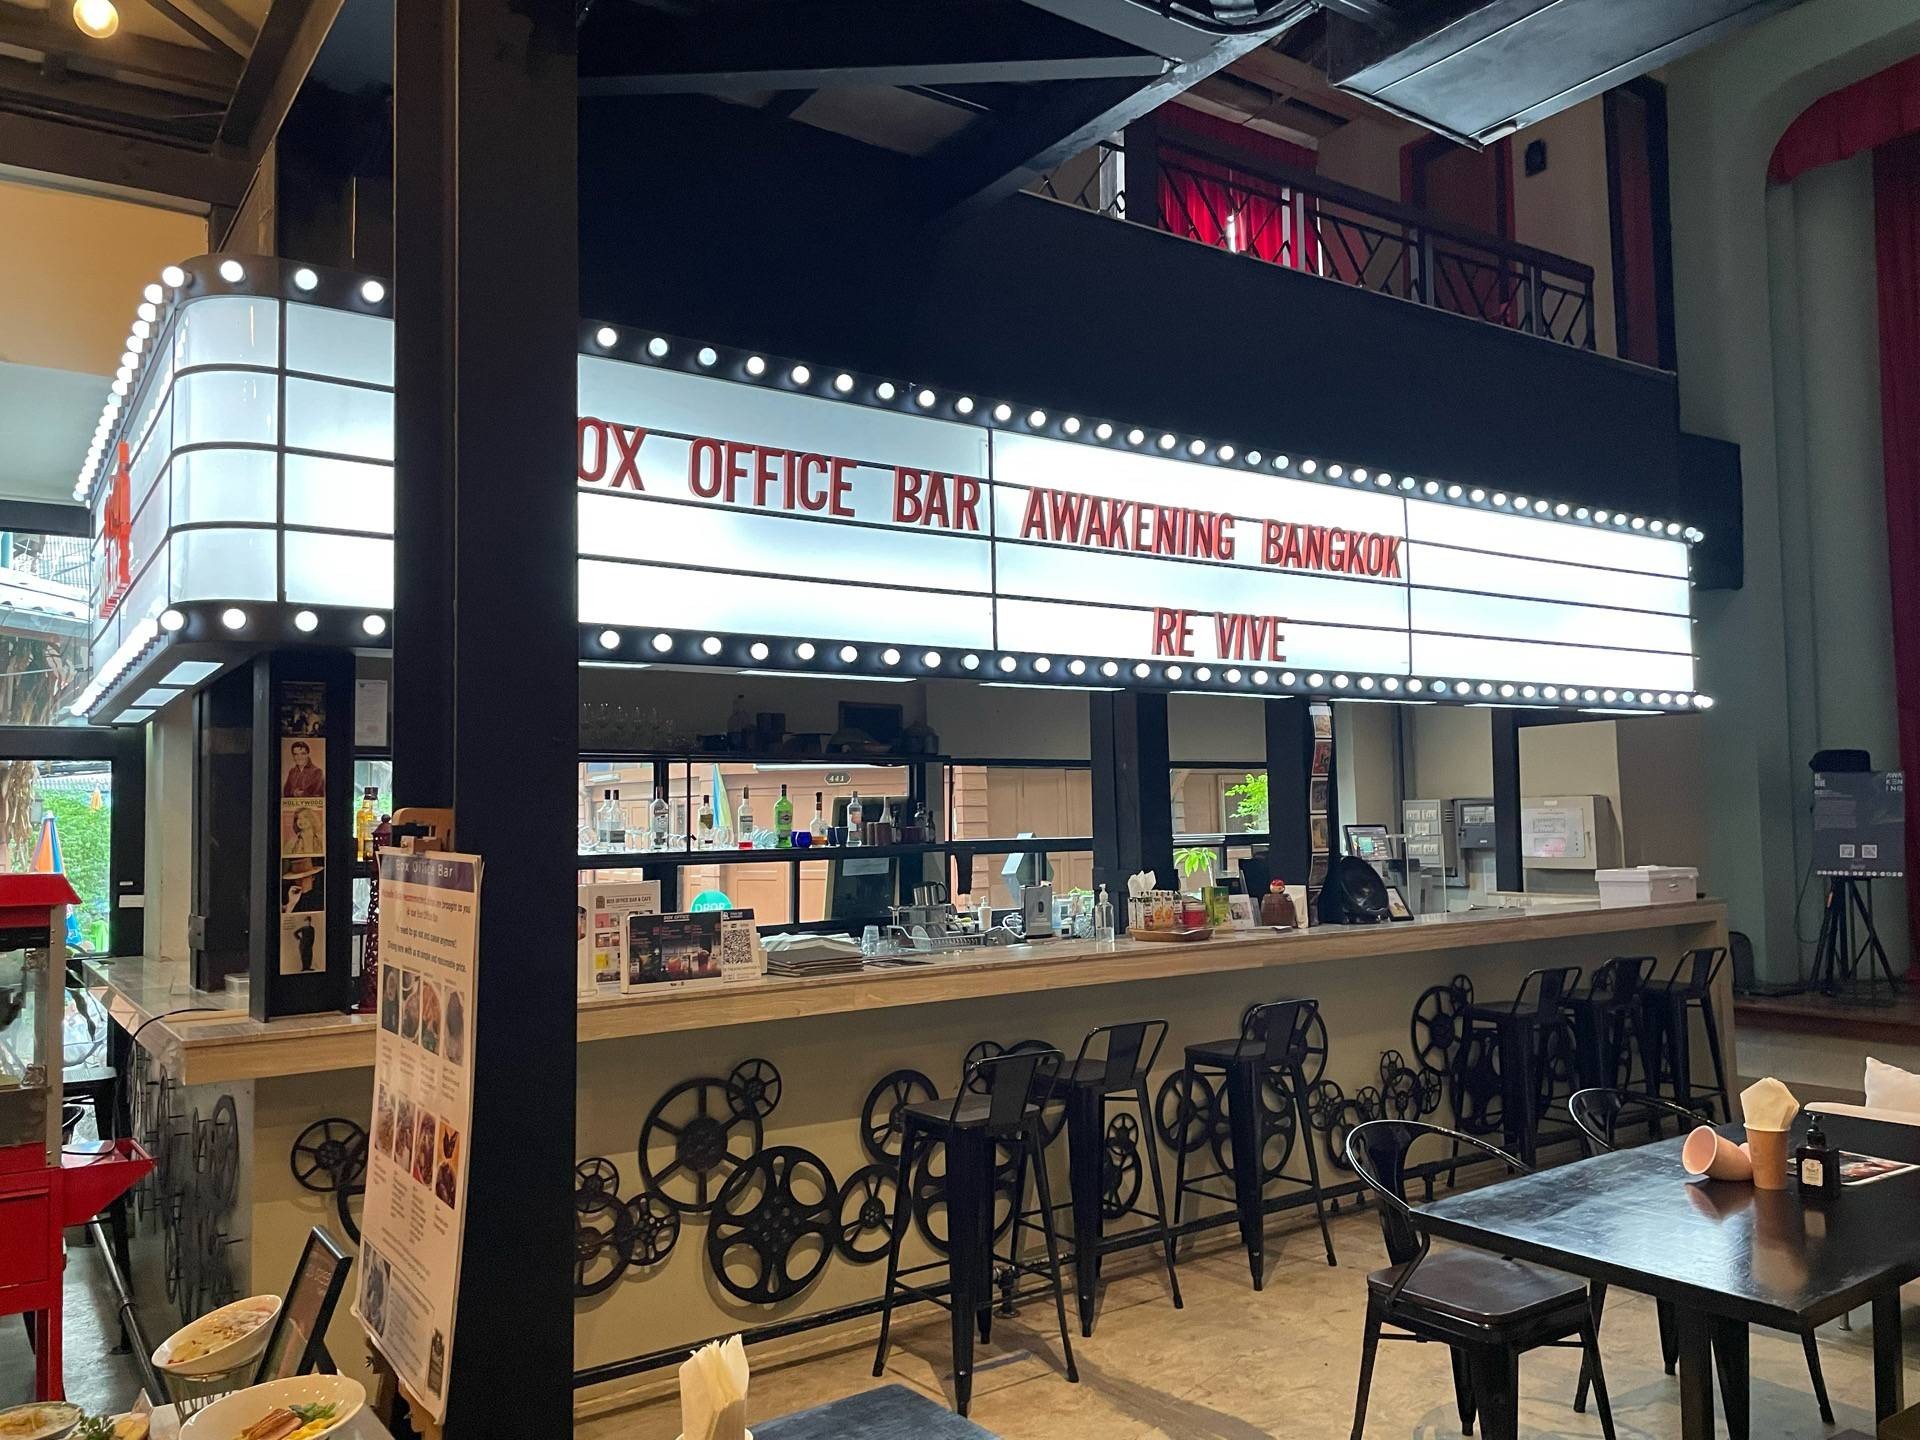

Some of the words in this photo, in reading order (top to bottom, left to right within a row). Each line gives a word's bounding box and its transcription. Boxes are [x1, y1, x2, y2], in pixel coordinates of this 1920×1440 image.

[689, 437, 858, 517] OFFICE
[892, 465, 981, 531] BAR
[1020, 487, 1236, 560] AWAKENING
[1261, 518, 1403, 578] BANGKOK
[1152, 607, 1198, 657] RE
[1213, 611, 1288, 662] VIVE
[438, 864, 453, 878] Bar
